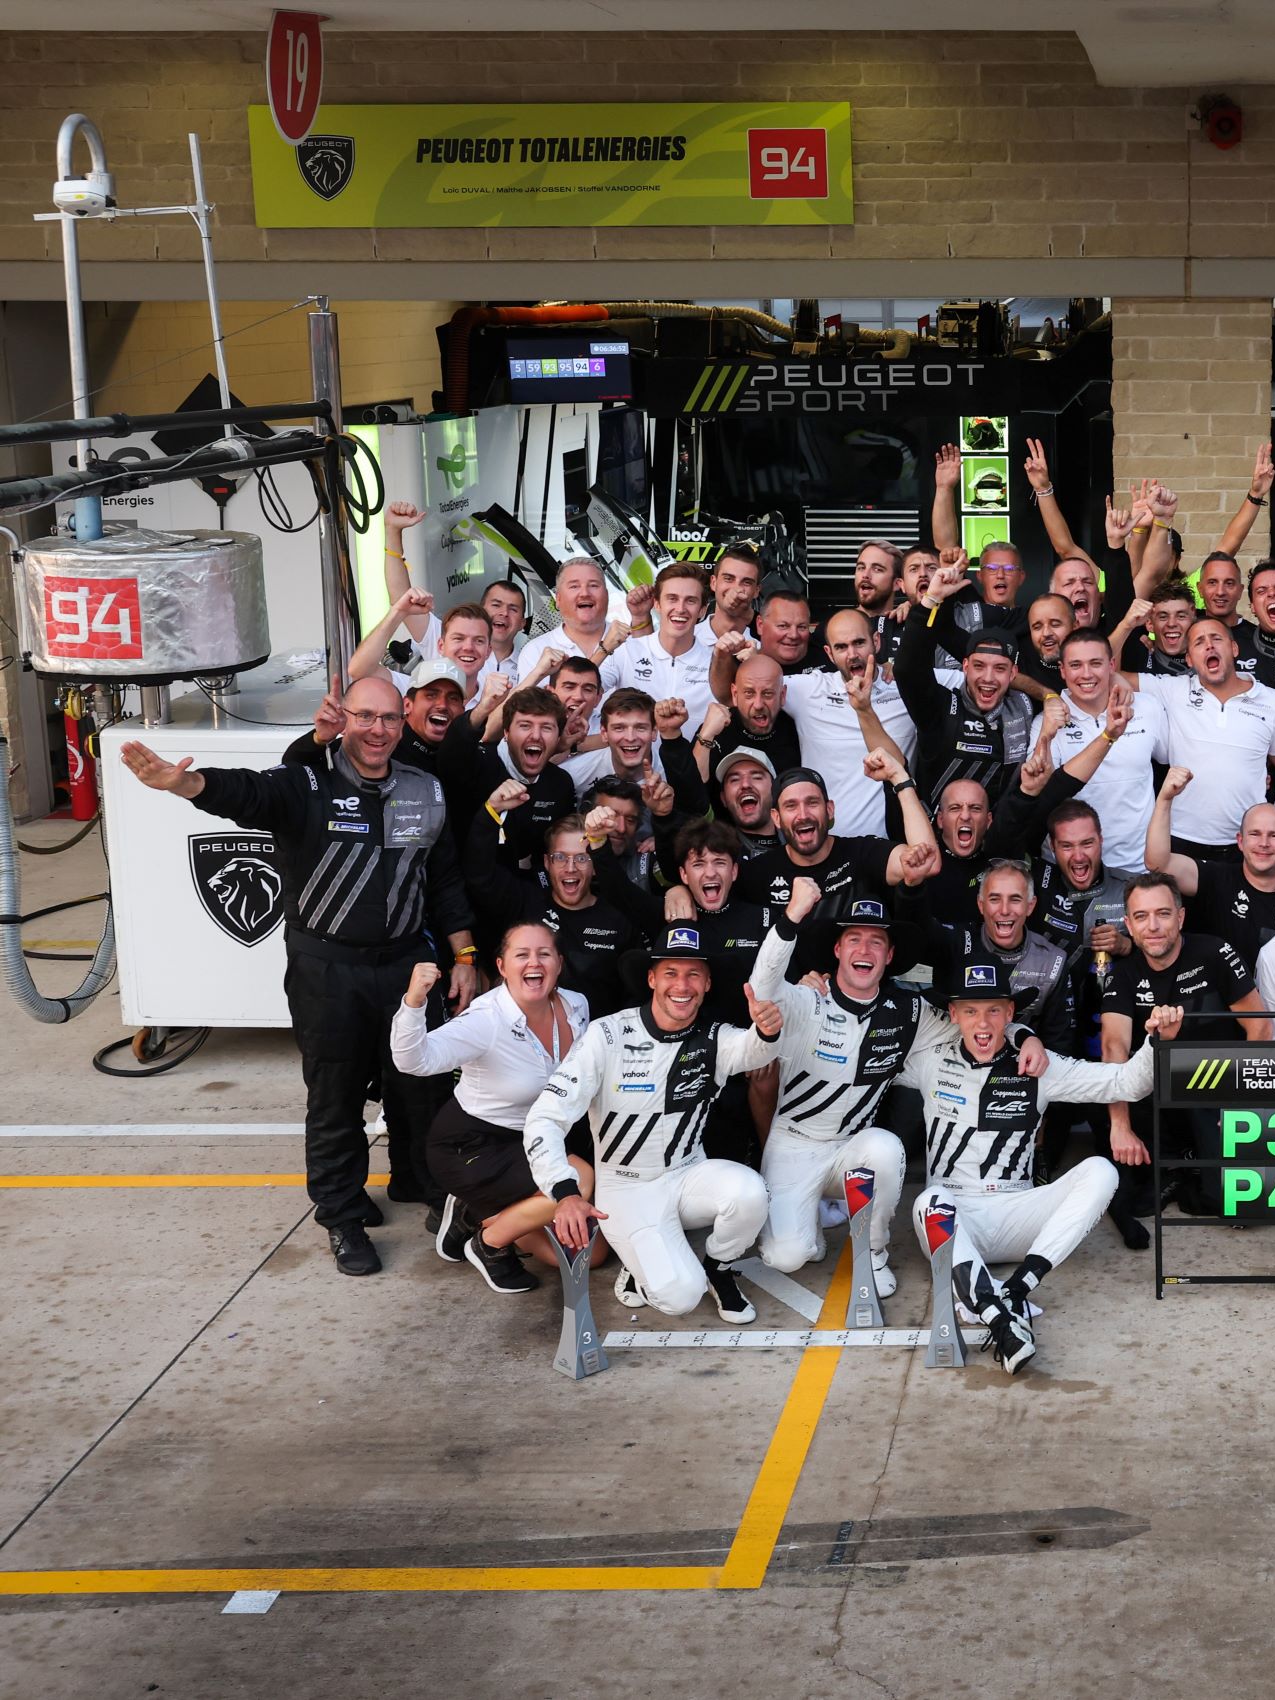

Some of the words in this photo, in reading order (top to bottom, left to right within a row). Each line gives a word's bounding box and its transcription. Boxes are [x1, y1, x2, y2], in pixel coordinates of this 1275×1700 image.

[286, 30, 308, 113] 19
[300, 141, 349, 149] PEUGEOT
[416, 138, 513, 164] PEUGEOT
[518, 136, 686, 163] TOTALENERGIES
[761, 147, 816, 181] 94
[577, 185, 604, 193] Stoffel
[515, 364, 521, 372] 5
[528, 363, 540, 372] 59
[544, 363, 556, 371] 93
[559, 363, 572, 371] 95
[575, 363, 588, 371] 94
[594, 362, 600, 371] 6
[751, 364, 985, 386] PEUGEOT
[735, 390, 899, 411] SPORT
[438, 497, 470, 515] TotalEnergies
[446, 564, 471, 594] yahoo!
[51, 586, 132, 646] 94
[392, 827, 422, 837] WEC
[199, 843, 275, 853] PEUGEO
[584, 941, 611, 950] Capgemini
[1049, 956, 1063, 980] sparco
[1180, 983, 1203, 994] Capgemini
[911, 997, 920, 1023] sparco
[600, 1021, 614, 1045] sparco
[818, 1039, 844, 1050] yahoo!
[871, 1044, 895, 1053] Capgemini
[864, 1051, 903, 1067] WEC
[622, 1070, 650, 1079] yahoo!
[937, 1079, 962, 1090] yahoo!
[992, 1089, 1021, 1098] Capgemini
[985, 1100, 1031, 1111] WEC
[615, 1169, 640, 1179] sparco
[859, 1286, 869, 1299] 3
[940, 1325, 950, 1338] 3
[582, 1331, 592, 1345] 3
